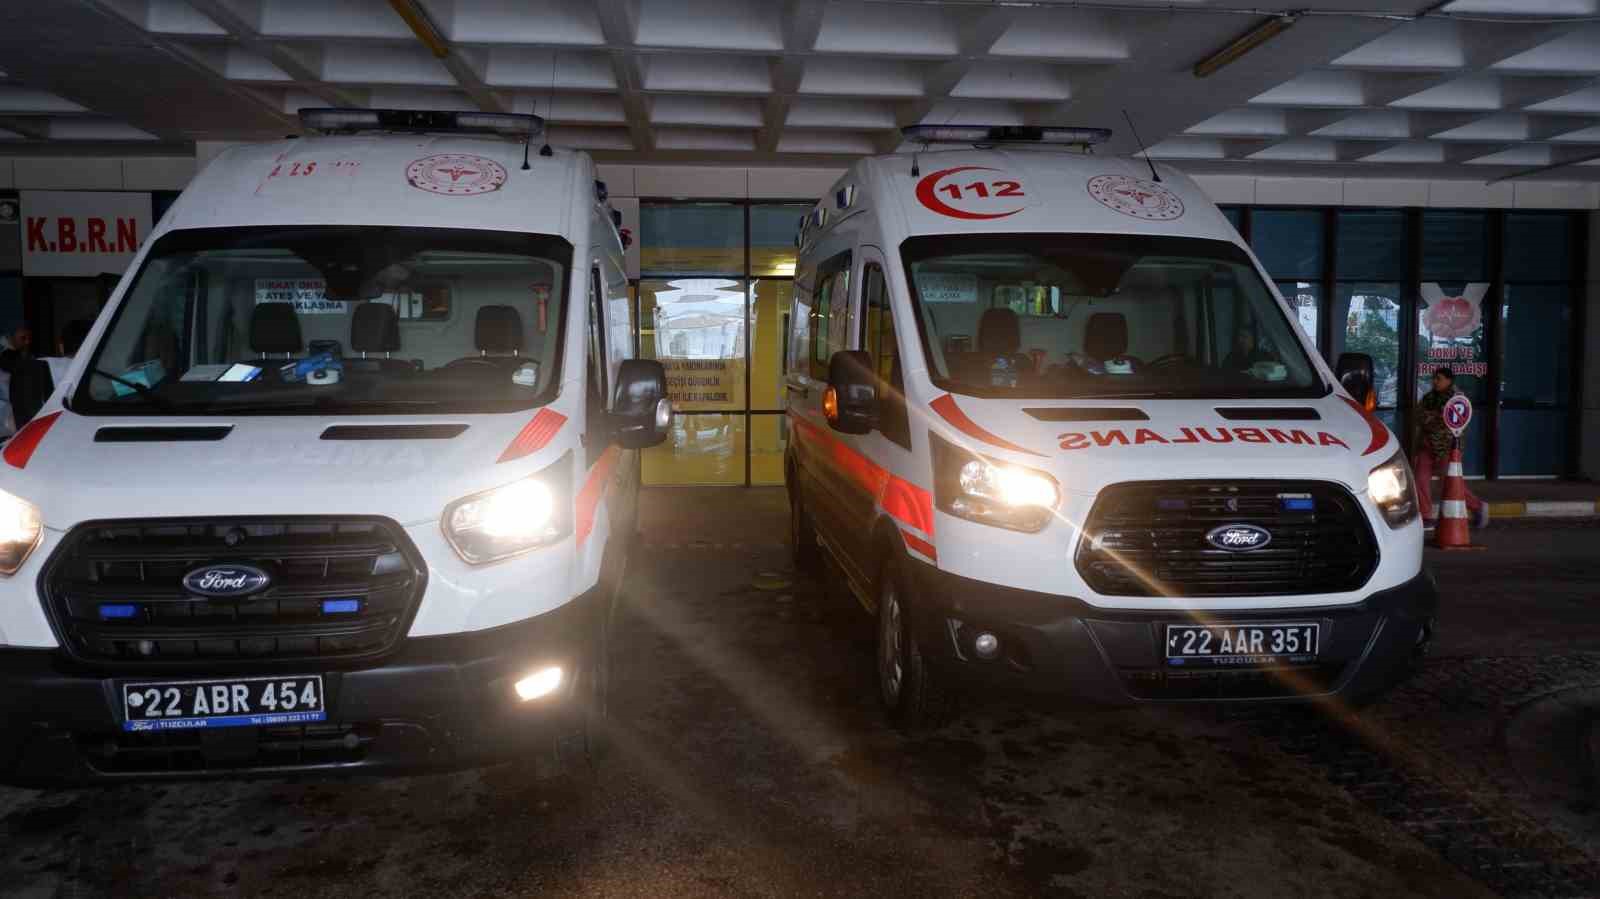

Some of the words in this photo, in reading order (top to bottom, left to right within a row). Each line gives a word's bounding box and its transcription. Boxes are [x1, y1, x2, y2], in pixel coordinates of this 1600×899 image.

[939, 180, 1025, 200] 112
[1457, 347, 1473, 358] VE
[1221, 528, 1260, 545] Ford
[199, 569, 247, 590] Ford
[1182, 629, 1213, 654] 22
[1219, 629, 1265, 654] AAR
[1270, 627, 1312, 653] 351
[144, 688, 182, 717] 22
[193, 684, 250, 715] ABR
[260, 680, 318, 711] 454
